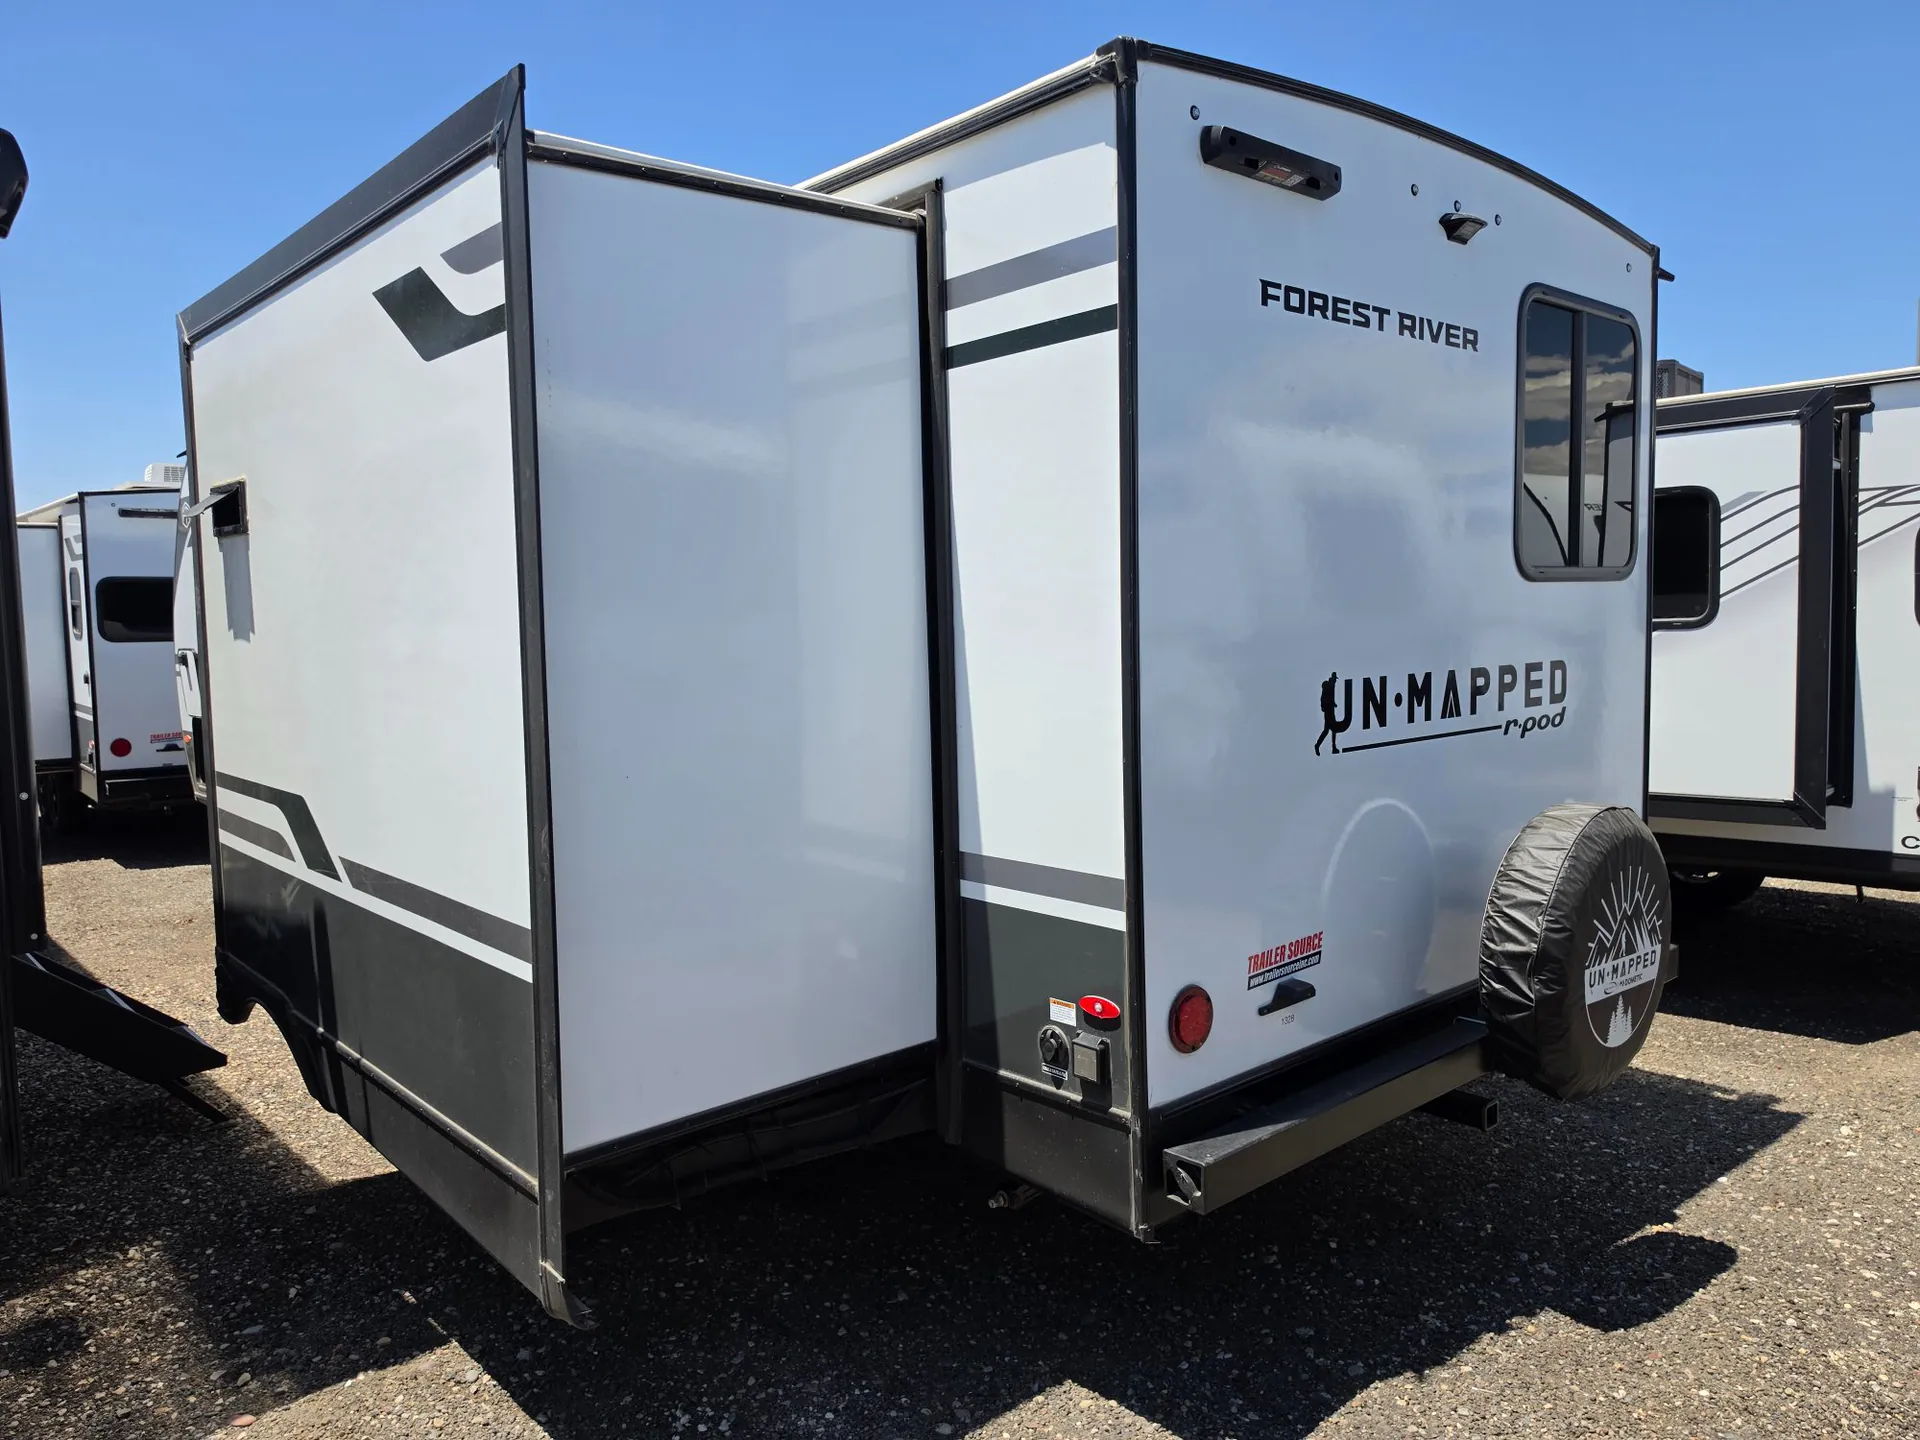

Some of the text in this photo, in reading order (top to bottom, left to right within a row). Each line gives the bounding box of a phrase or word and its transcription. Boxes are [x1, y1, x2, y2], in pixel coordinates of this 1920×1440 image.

[1259, 278, 1479, 352] FOREST RIVER
[1247, 931, 1324, 975] TRAILER SOURCE
